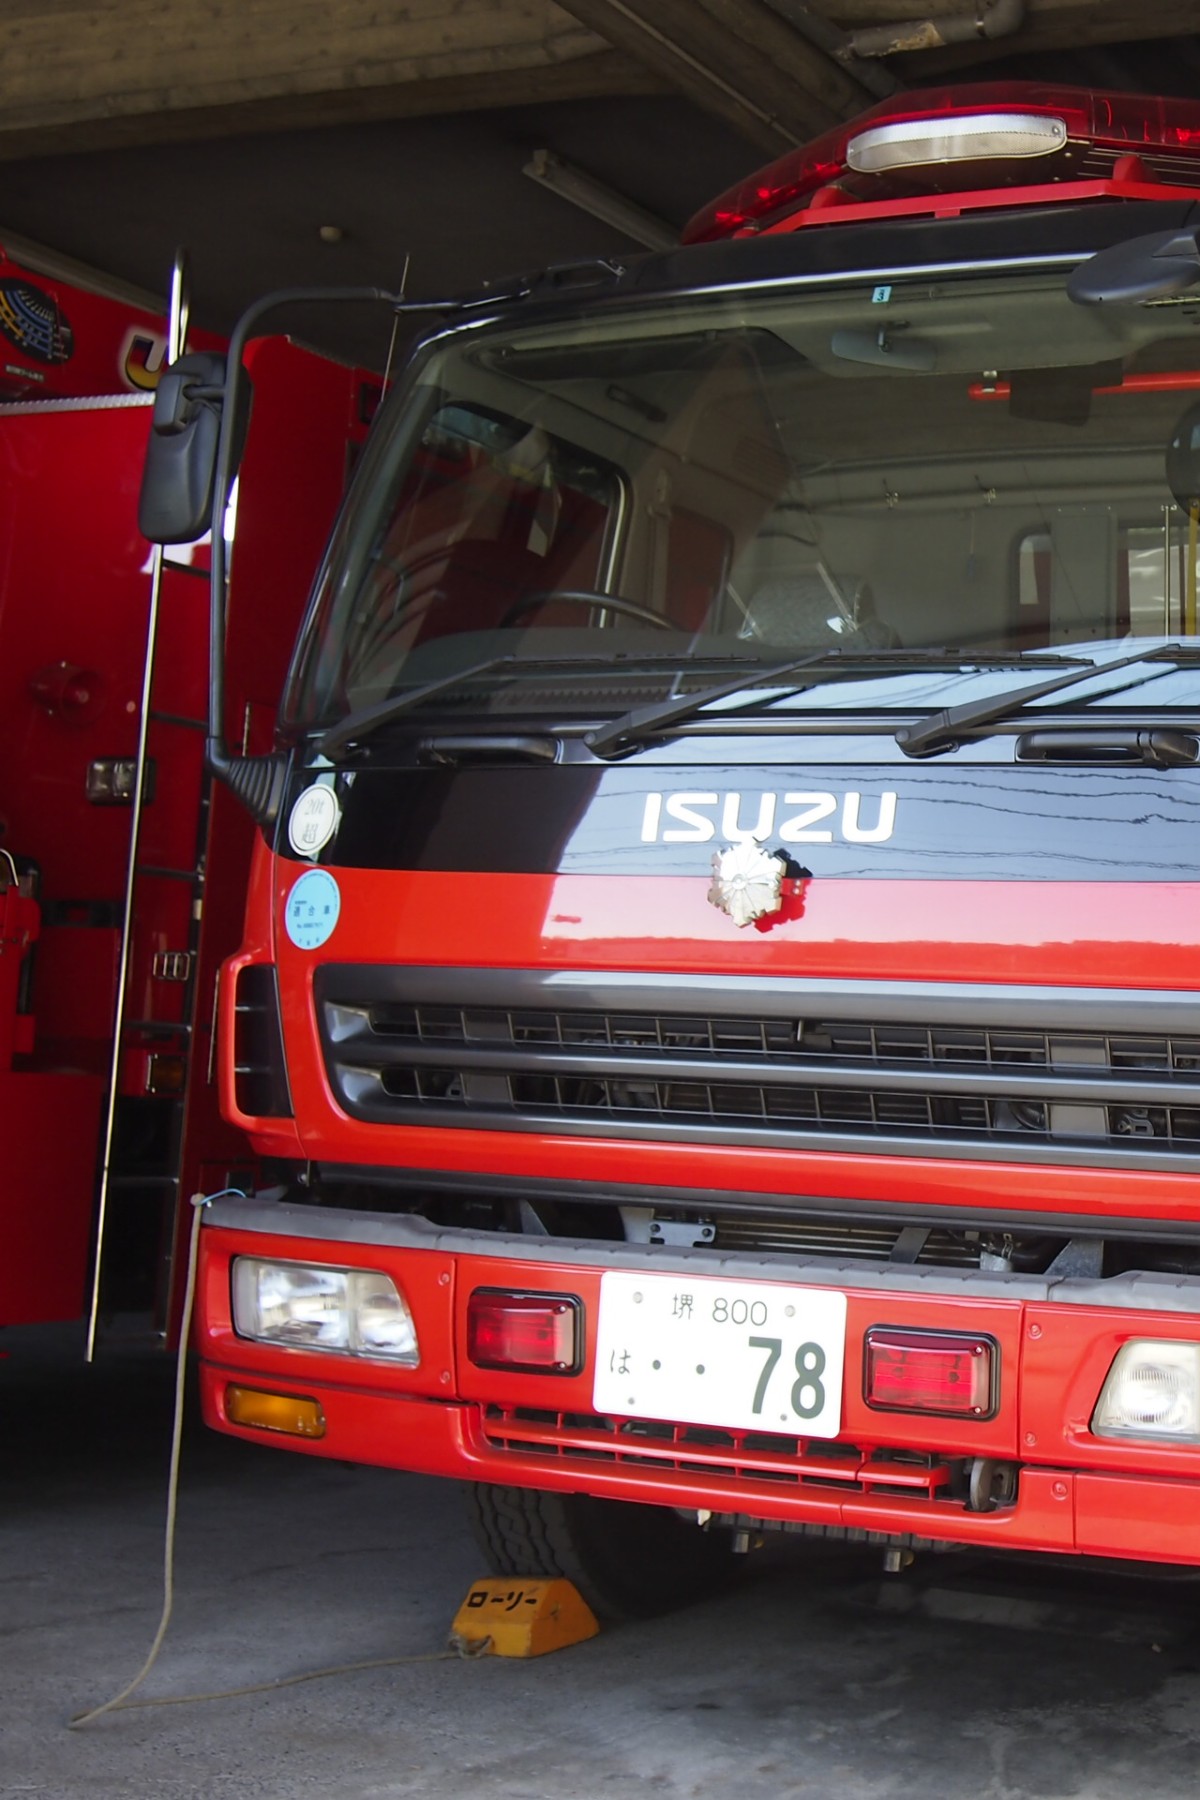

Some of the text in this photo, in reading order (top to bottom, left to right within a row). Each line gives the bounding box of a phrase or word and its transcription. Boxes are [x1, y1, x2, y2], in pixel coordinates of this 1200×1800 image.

[641, 792, 897, 843] ISUZU
[672, 1293, 768, 1326] 堺 800
[610, 1349, 632, 1375] は
[467, 1591, 538, 1612] ローリー
